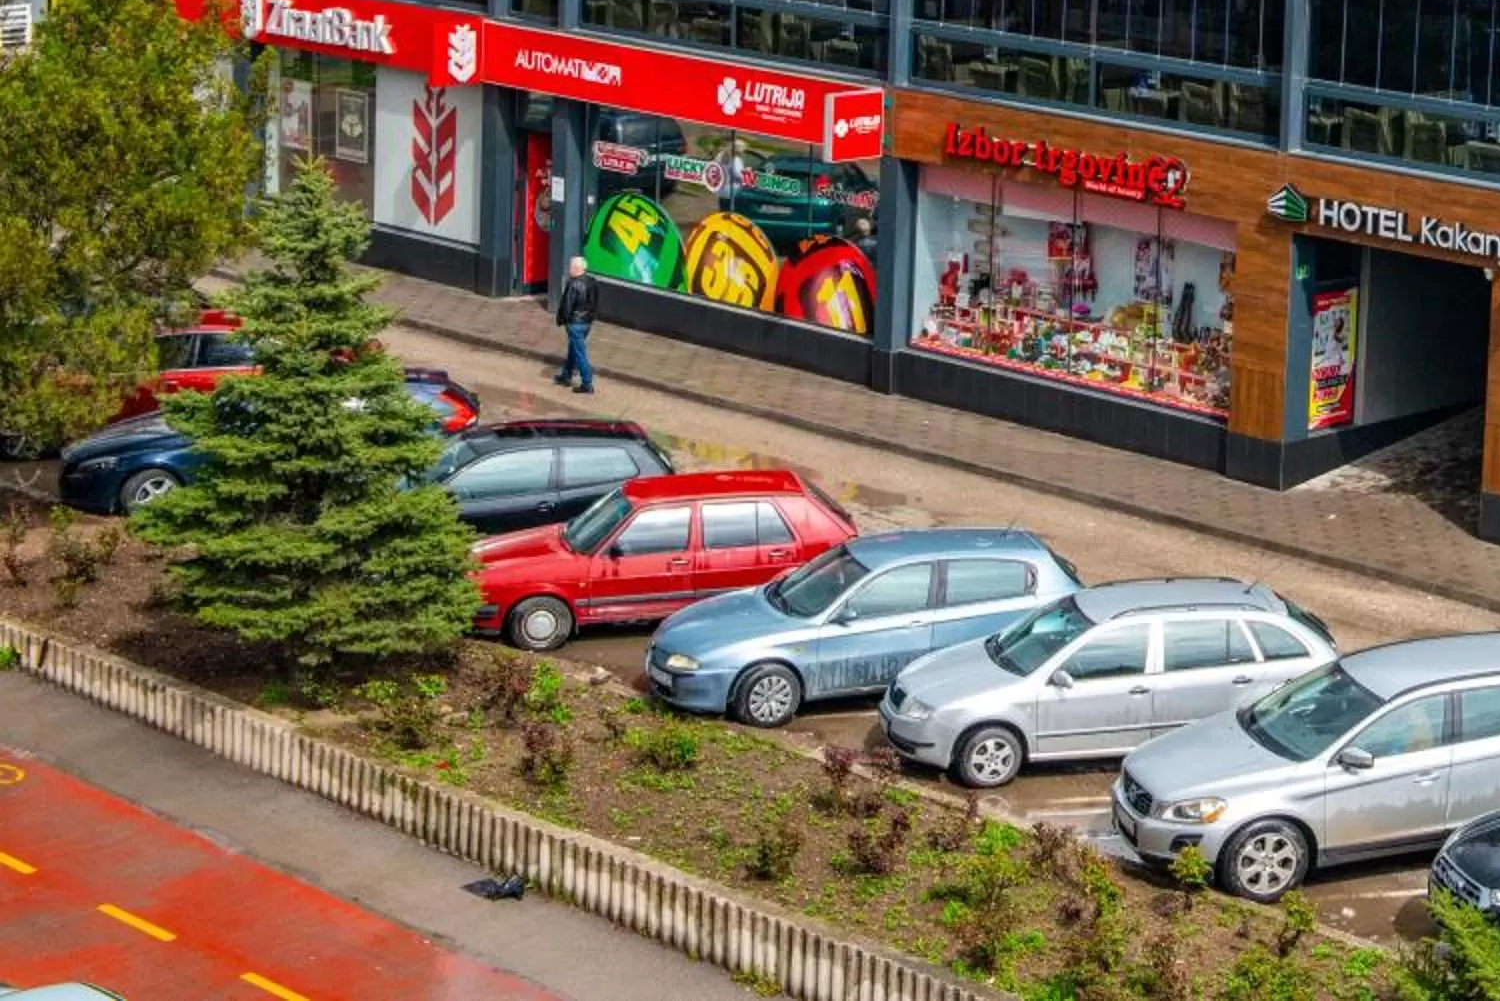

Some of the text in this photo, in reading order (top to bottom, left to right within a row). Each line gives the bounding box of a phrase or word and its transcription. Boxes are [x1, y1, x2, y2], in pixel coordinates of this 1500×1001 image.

[744, 80, 805, 110] LUTRIJA
[945, 122, 1026, 166] Izbor
[1318, 198, 1413, 243] HOTEL
